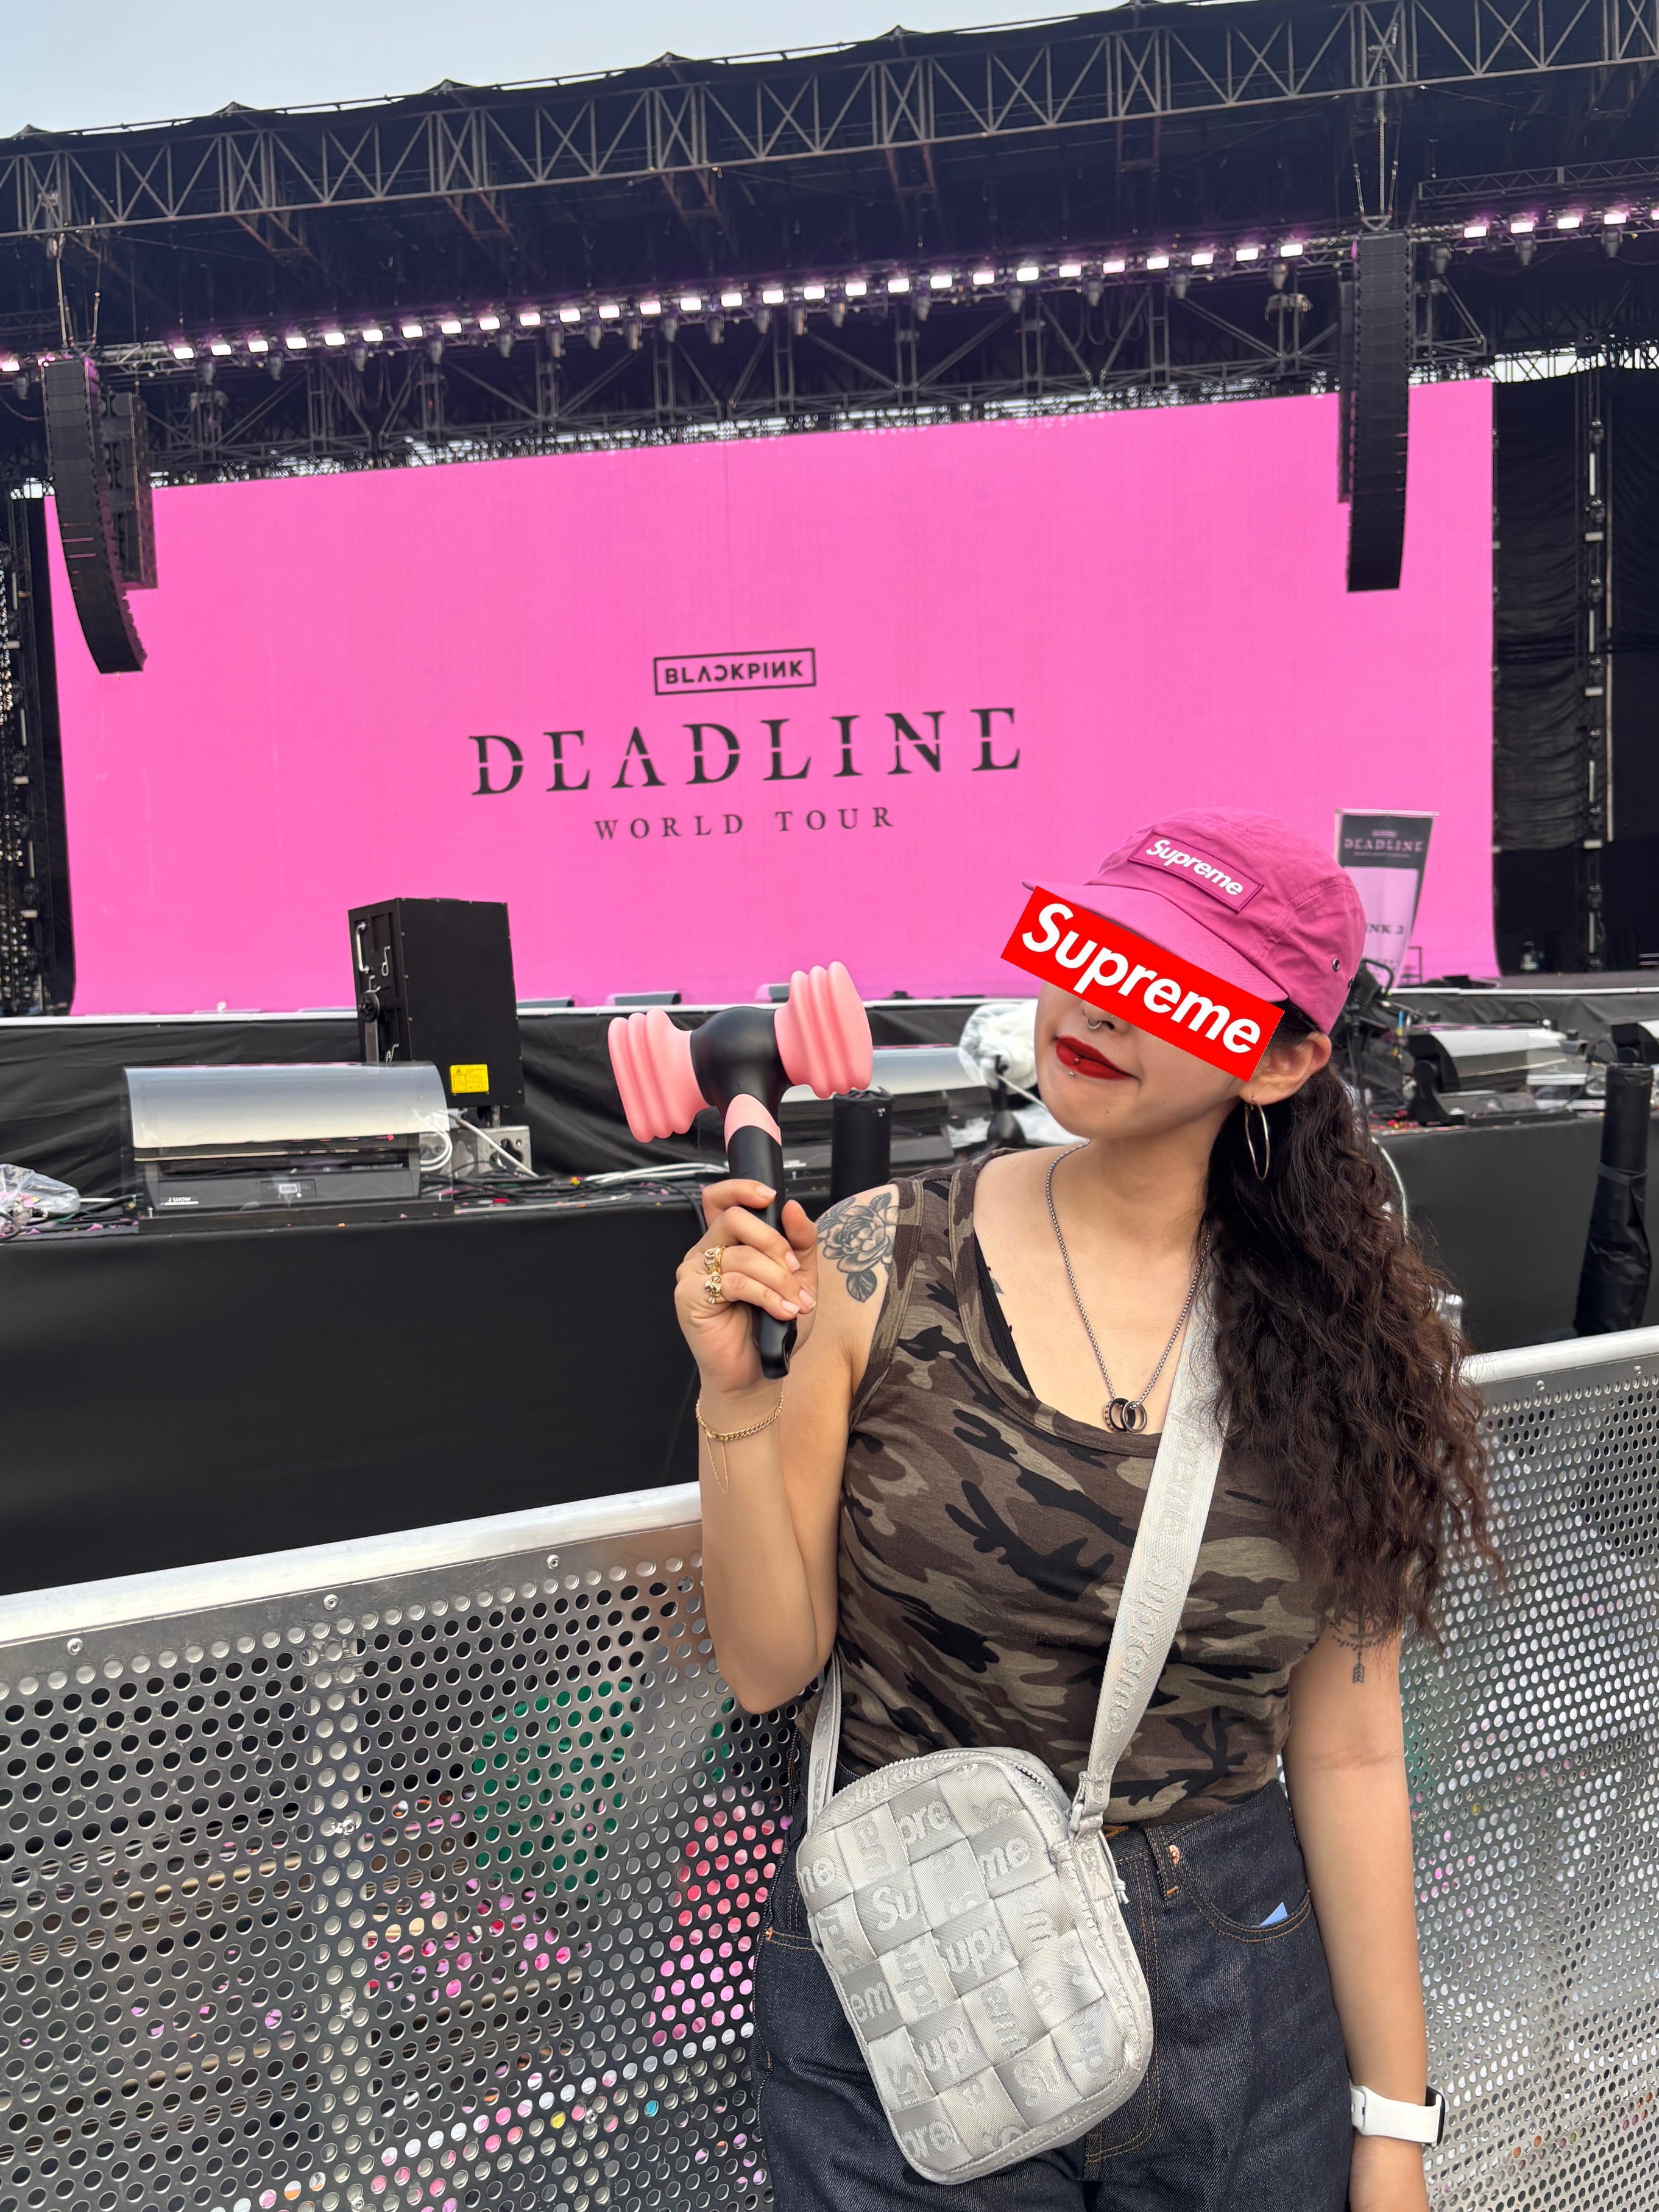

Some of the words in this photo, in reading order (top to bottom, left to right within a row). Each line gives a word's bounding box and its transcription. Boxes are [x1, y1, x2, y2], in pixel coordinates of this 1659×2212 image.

[469, 707, 1021, 796] DEADLINE
[594, 814, 743, 840] WORLD
[774, 806, 894, 833] TOUR
[1344, 837, 1424, 853] DEADLINE
[1146, 839, 1243, 895] Supreme
